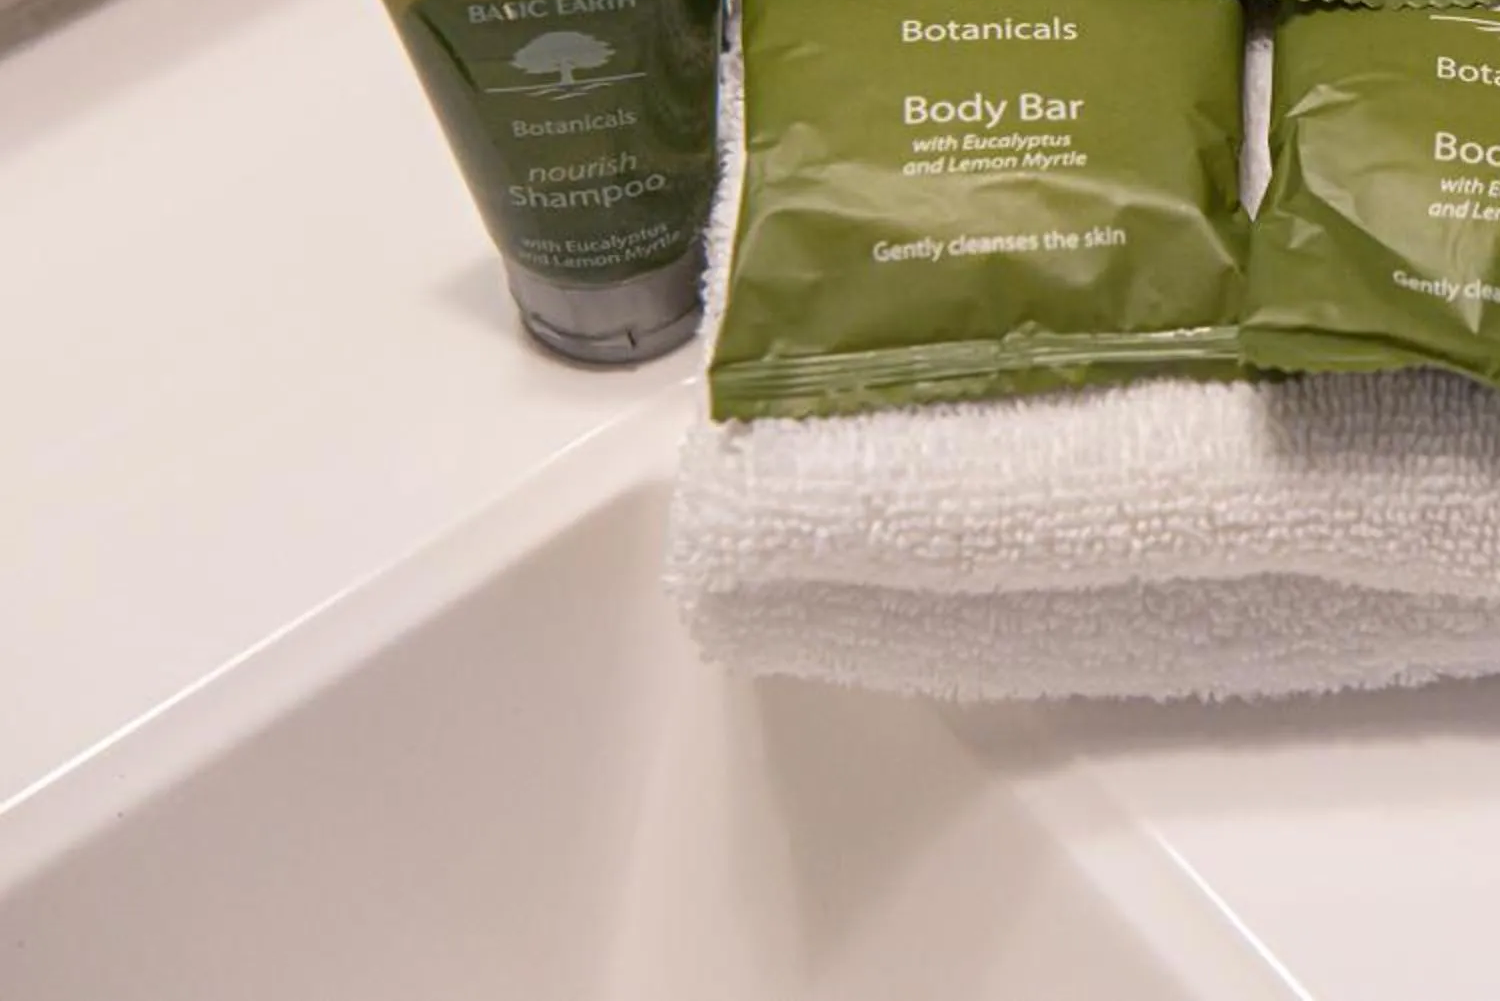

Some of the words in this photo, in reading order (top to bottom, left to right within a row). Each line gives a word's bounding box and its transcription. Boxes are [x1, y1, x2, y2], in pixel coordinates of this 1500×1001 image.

[467, 0, 548, 24] BASIC
[902, 17, 1078, 42] Botanicals
[512, 108, 638, 138] Botanicals
[903, 94, 1007, 129] Body
[1019, 94, 1084, 122] Bar
[912, 135, 958, 152] with
[962, 132, 1072, 153] Eucalyptus
[528, 151, 637, 183] nourish
[903, 156, 943, 177] and
[947, 153, 1018, 172] Lemon
[1021, 151, 1088, 173] Myrtle
[508, 174, 666, 209] Shampoo
[1440, 176, 1484, 197] with
[1428, 200, 1469, 220] and
[565, 222, 668, 253] Eucalyptus
[873, 238, 944, 263] Gently
[948, 232, 1039, 256] cleanses
[1043, 230, 1079, 251] the
[1081, 227, 1126, 249] skin
[1392, 269, 1460, 302] Gently
